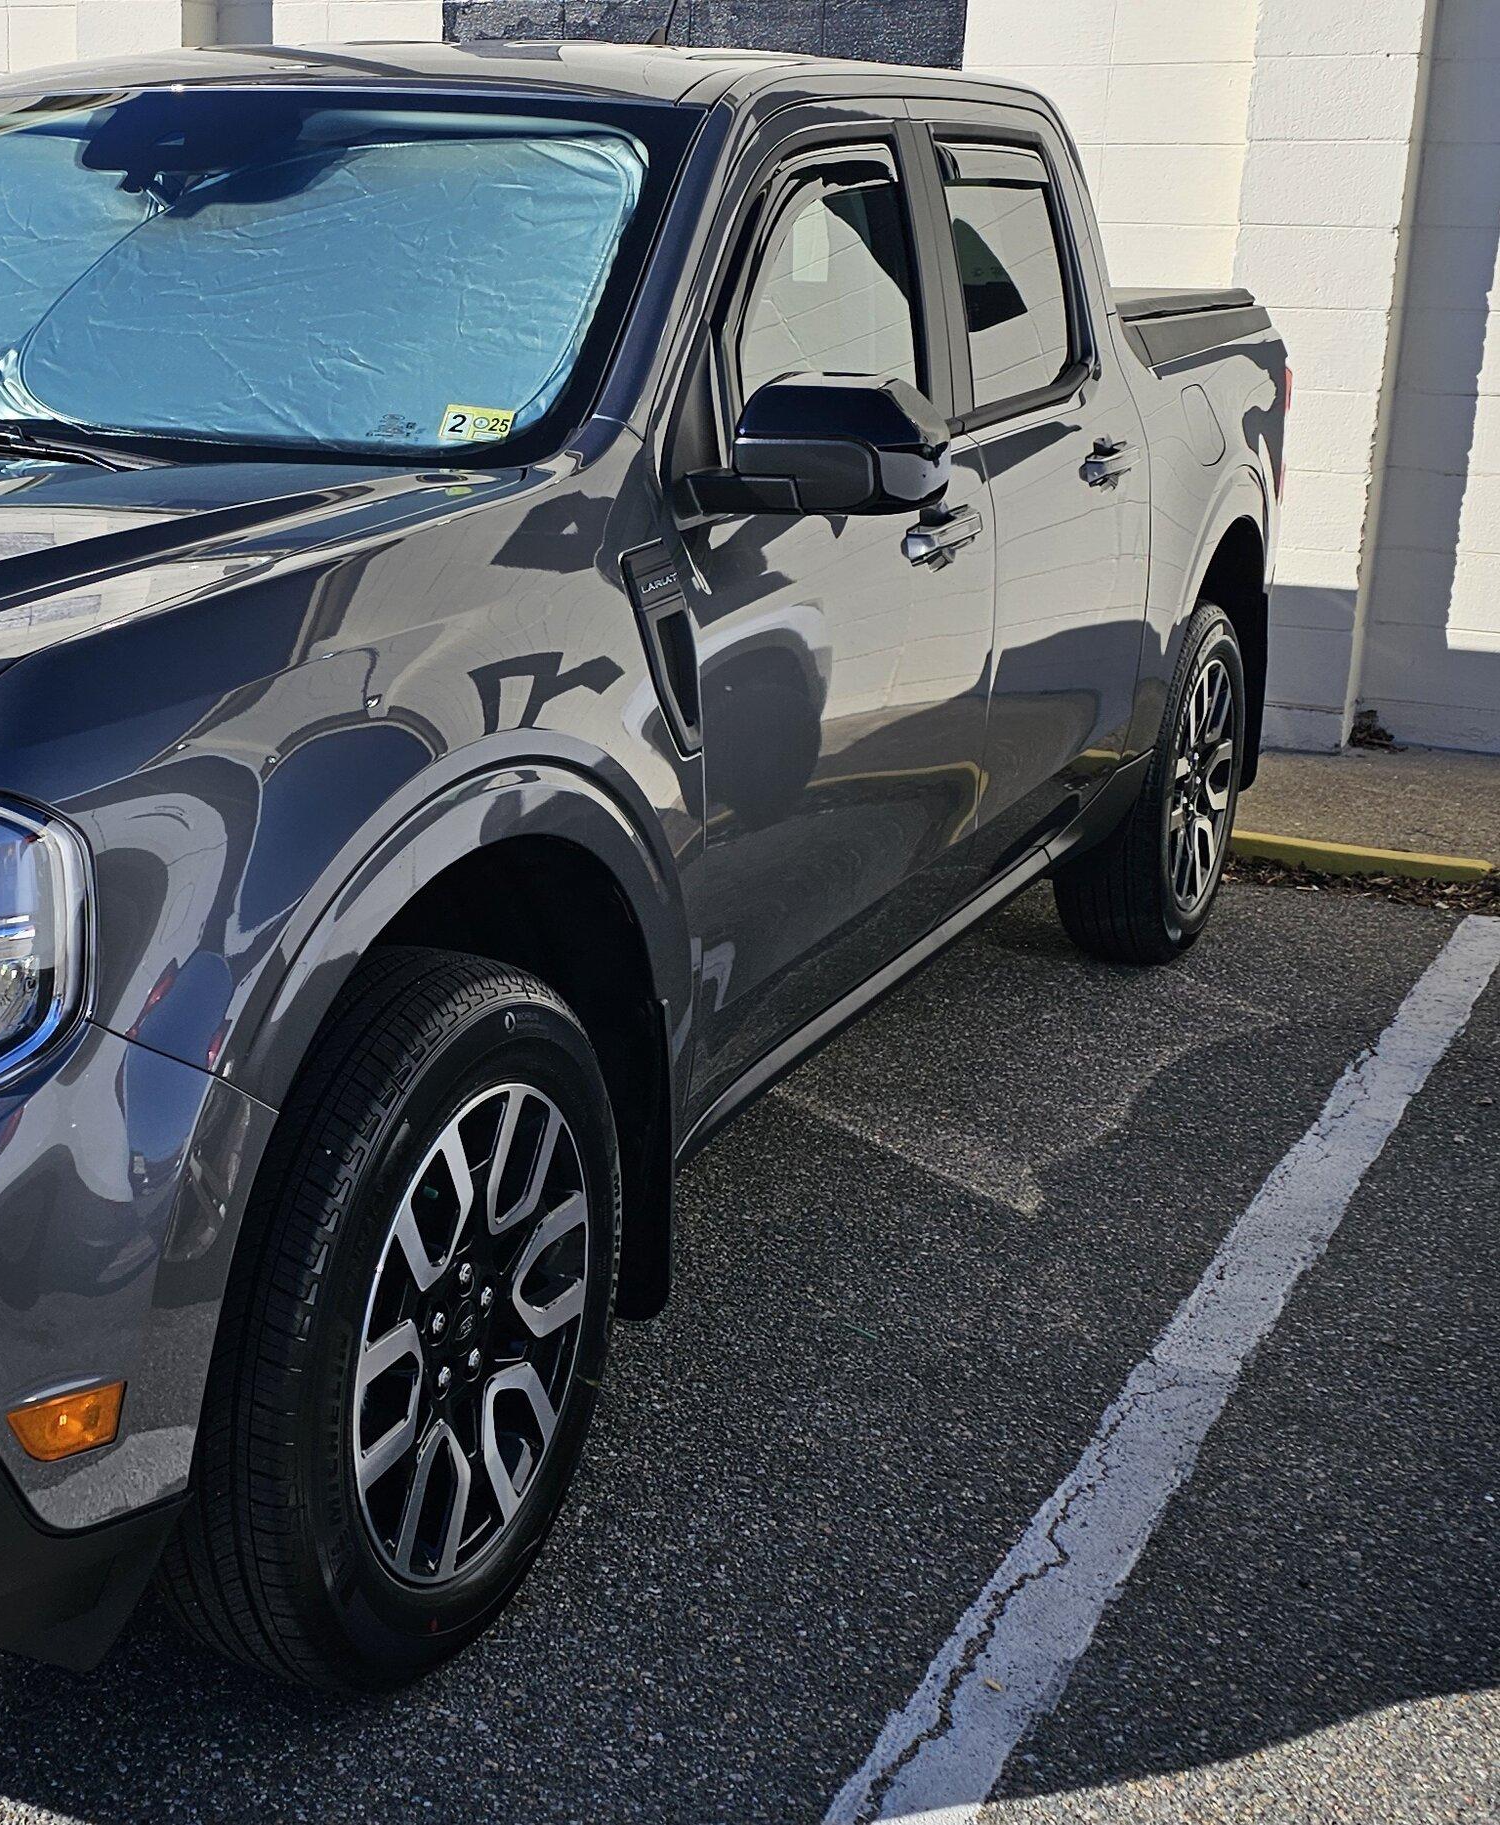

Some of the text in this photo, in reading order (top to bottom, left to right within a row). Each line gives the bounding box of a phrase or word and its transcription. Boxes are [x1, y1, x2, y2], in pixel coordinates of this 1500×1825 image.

[448, 414, 510, 433] 2 25
[641, 572, 678, 594] LARIAT
